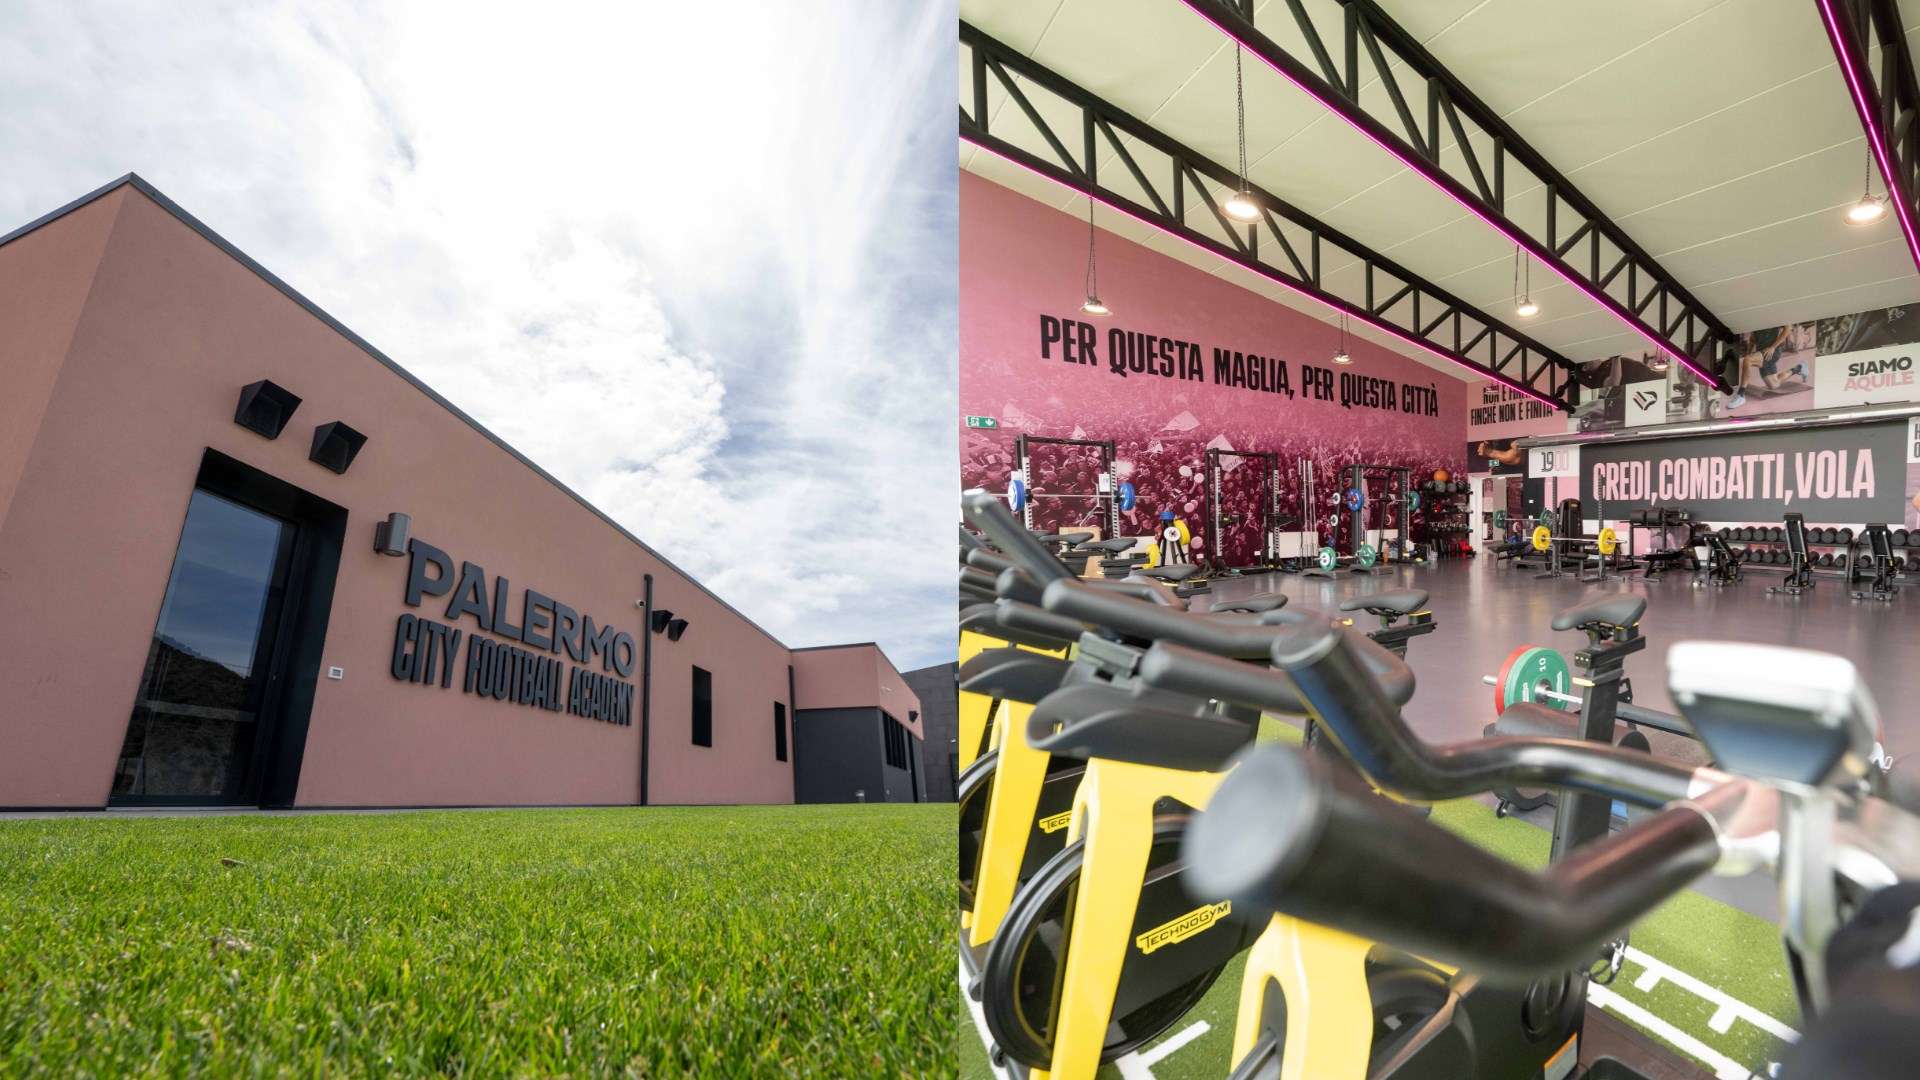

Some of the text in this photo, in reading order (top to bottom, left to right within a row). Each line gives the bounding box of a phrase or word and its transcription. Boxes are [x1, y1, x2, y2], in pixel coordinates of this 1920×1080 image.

[1040, 314, 1439, 417] PER QUESTA MAGLIA, PER QUESTA CITTÀ
[1848, 356, 1912, 377] SIAMO
[1844, 371, 1915, 392] AQUILE
[1499, 403, 1516, 423] NON
[404, 537, 636, 678] PALERMO
[391, 613, 634, 726] CITY FOOTBALL ACADEMY
[1044, 814, 1072, 830] TECH
